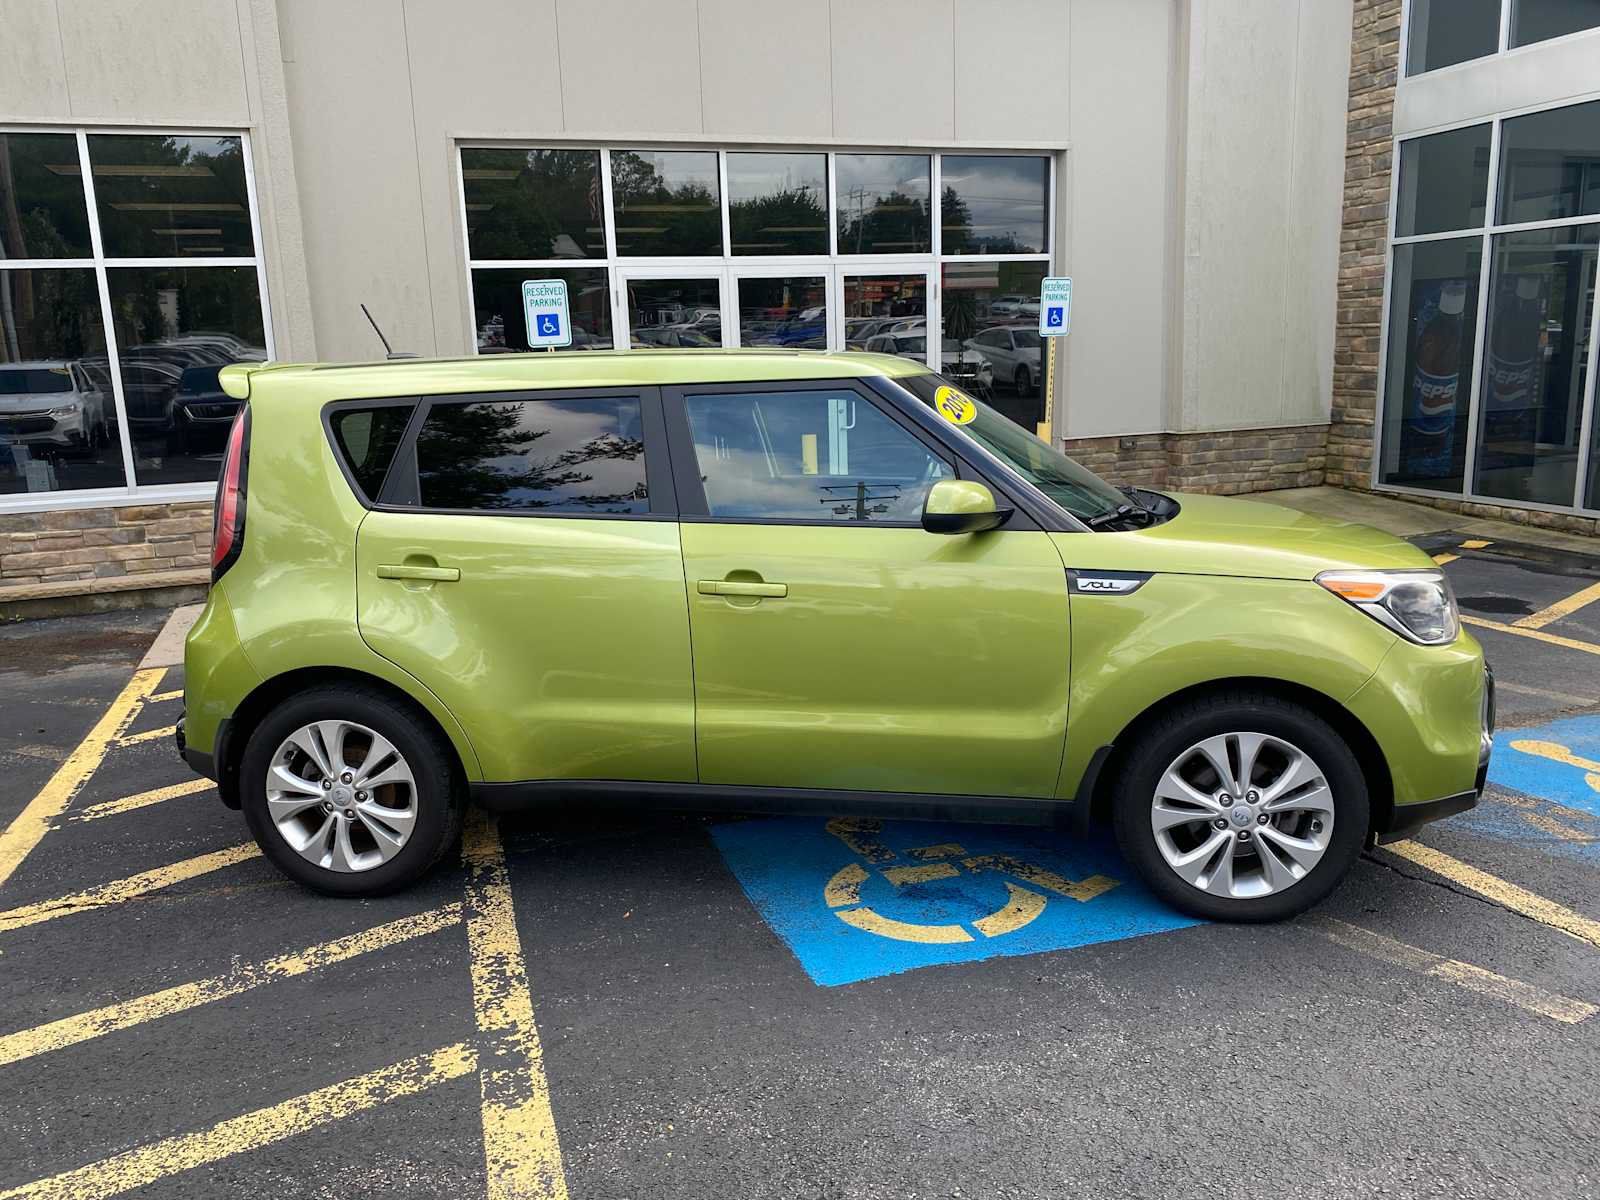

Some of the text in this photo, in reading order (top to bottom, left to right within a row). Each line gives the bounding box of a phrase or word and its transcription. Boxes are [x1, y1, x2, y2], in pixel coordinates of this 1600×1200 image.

[526, 287, 564, 297] RESERVED
[1045, 293, 1068, 301] PARKING
[530, 298, 562, 307] PARKING
[1412, 376, 1456, 398] PEPS
